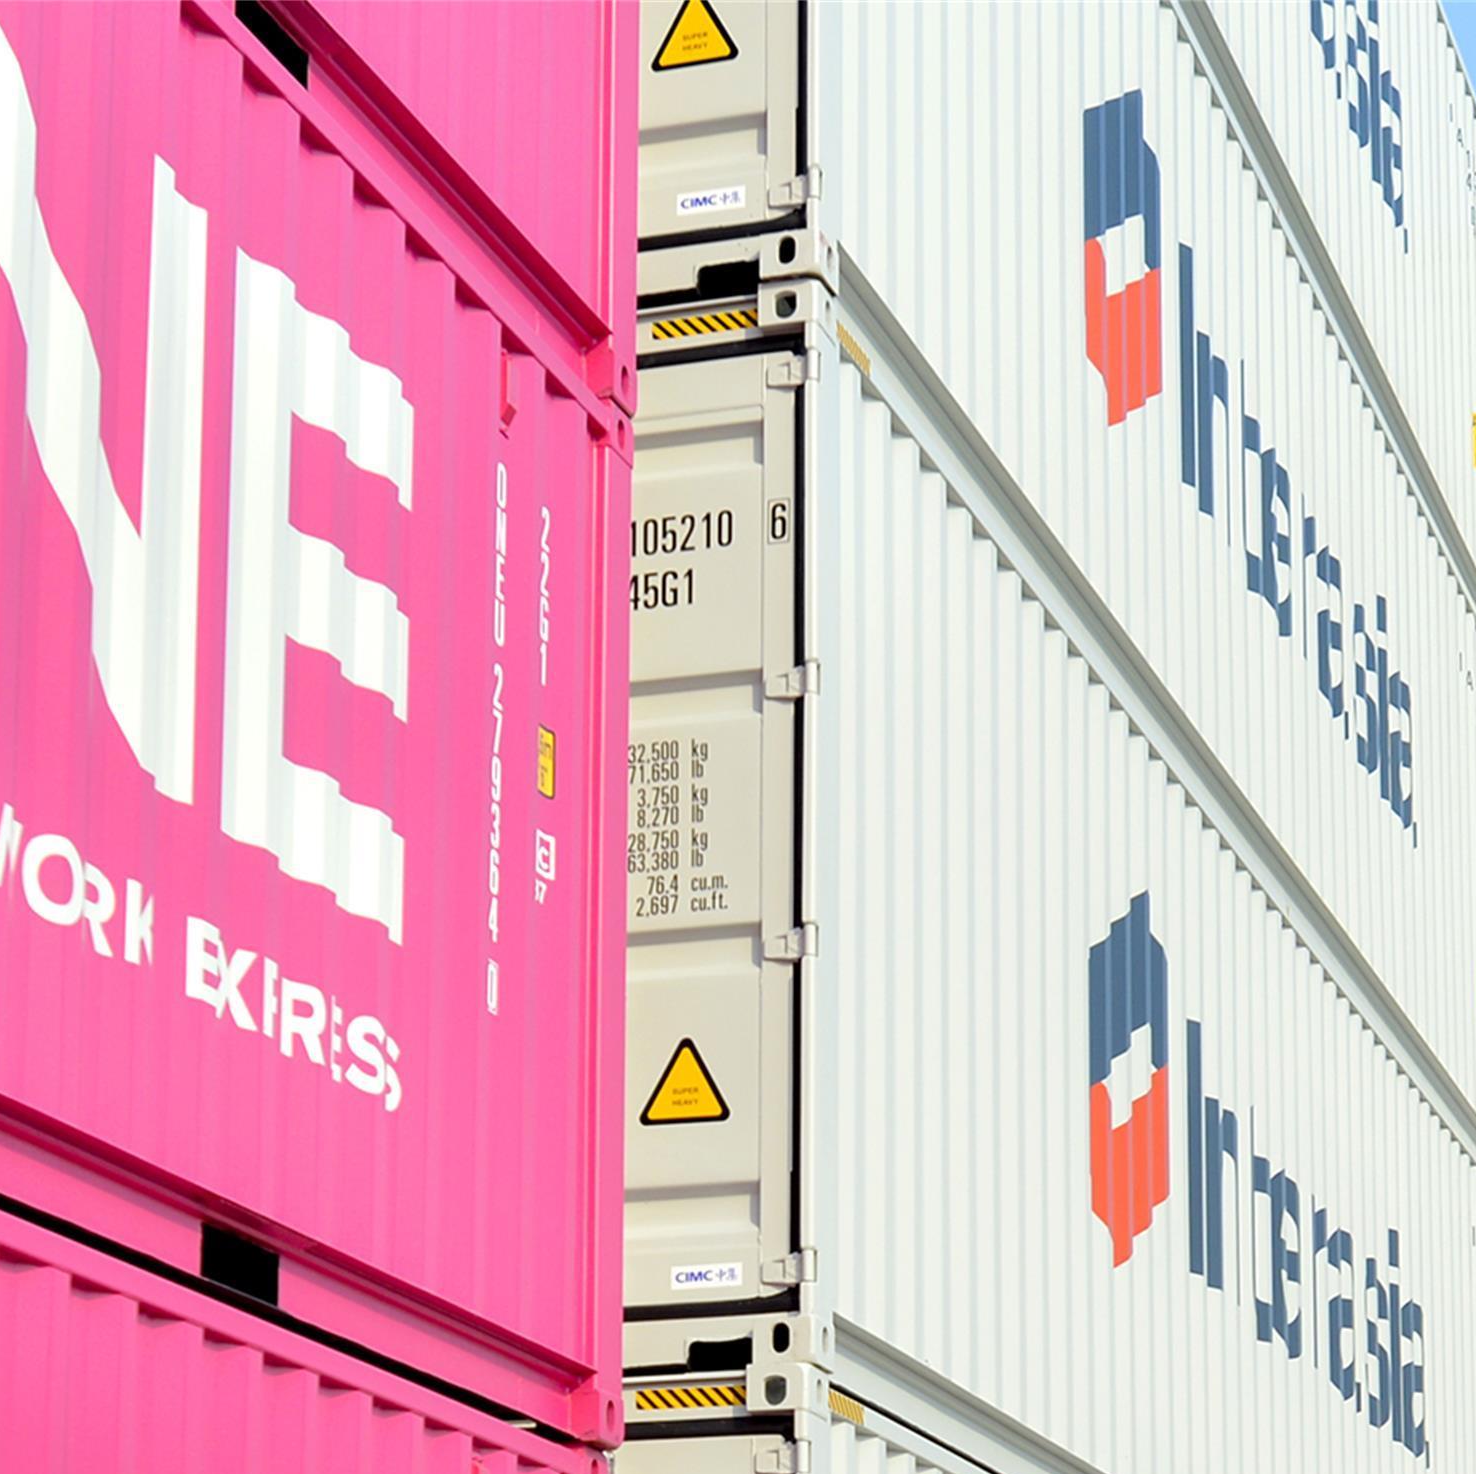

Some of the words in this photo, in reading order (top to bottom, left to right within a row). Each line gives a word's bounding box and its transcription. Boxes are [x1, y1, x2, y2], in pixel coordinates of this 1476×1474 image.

[680, 193, 718, 210] CIMC
[631, 509, 733, 557] 105210
[770, 502, 788, 541] 6
[629, 568, 694, 611] 45G1
[627, 740, 680, 764] 32,500
[690, 738, 709, 762] kg
[628, 761, 680, 785] 71,650
[691, 760, 705, 778] lb
[637, 785, 680, 808] 3,750
[690, 783, 709, 806] kg
[637, 806, 680, 829] 8,270
[691, 804, 705, 823] lb
[627, 830, 680, 853] 28,750
[690, 828, 709, 851] kg
[627, 851, 680, 874] 63,380
[691, 849, 705, 868] lb
[646, 874, 679, 896] 76.4
[690, 875, 729, 891] cu.m.
[636, 895, 679, 917] 2,697
[690, 892, 729, 912] cu.ft.
[675, 1269, 713, 1284] CIMC
